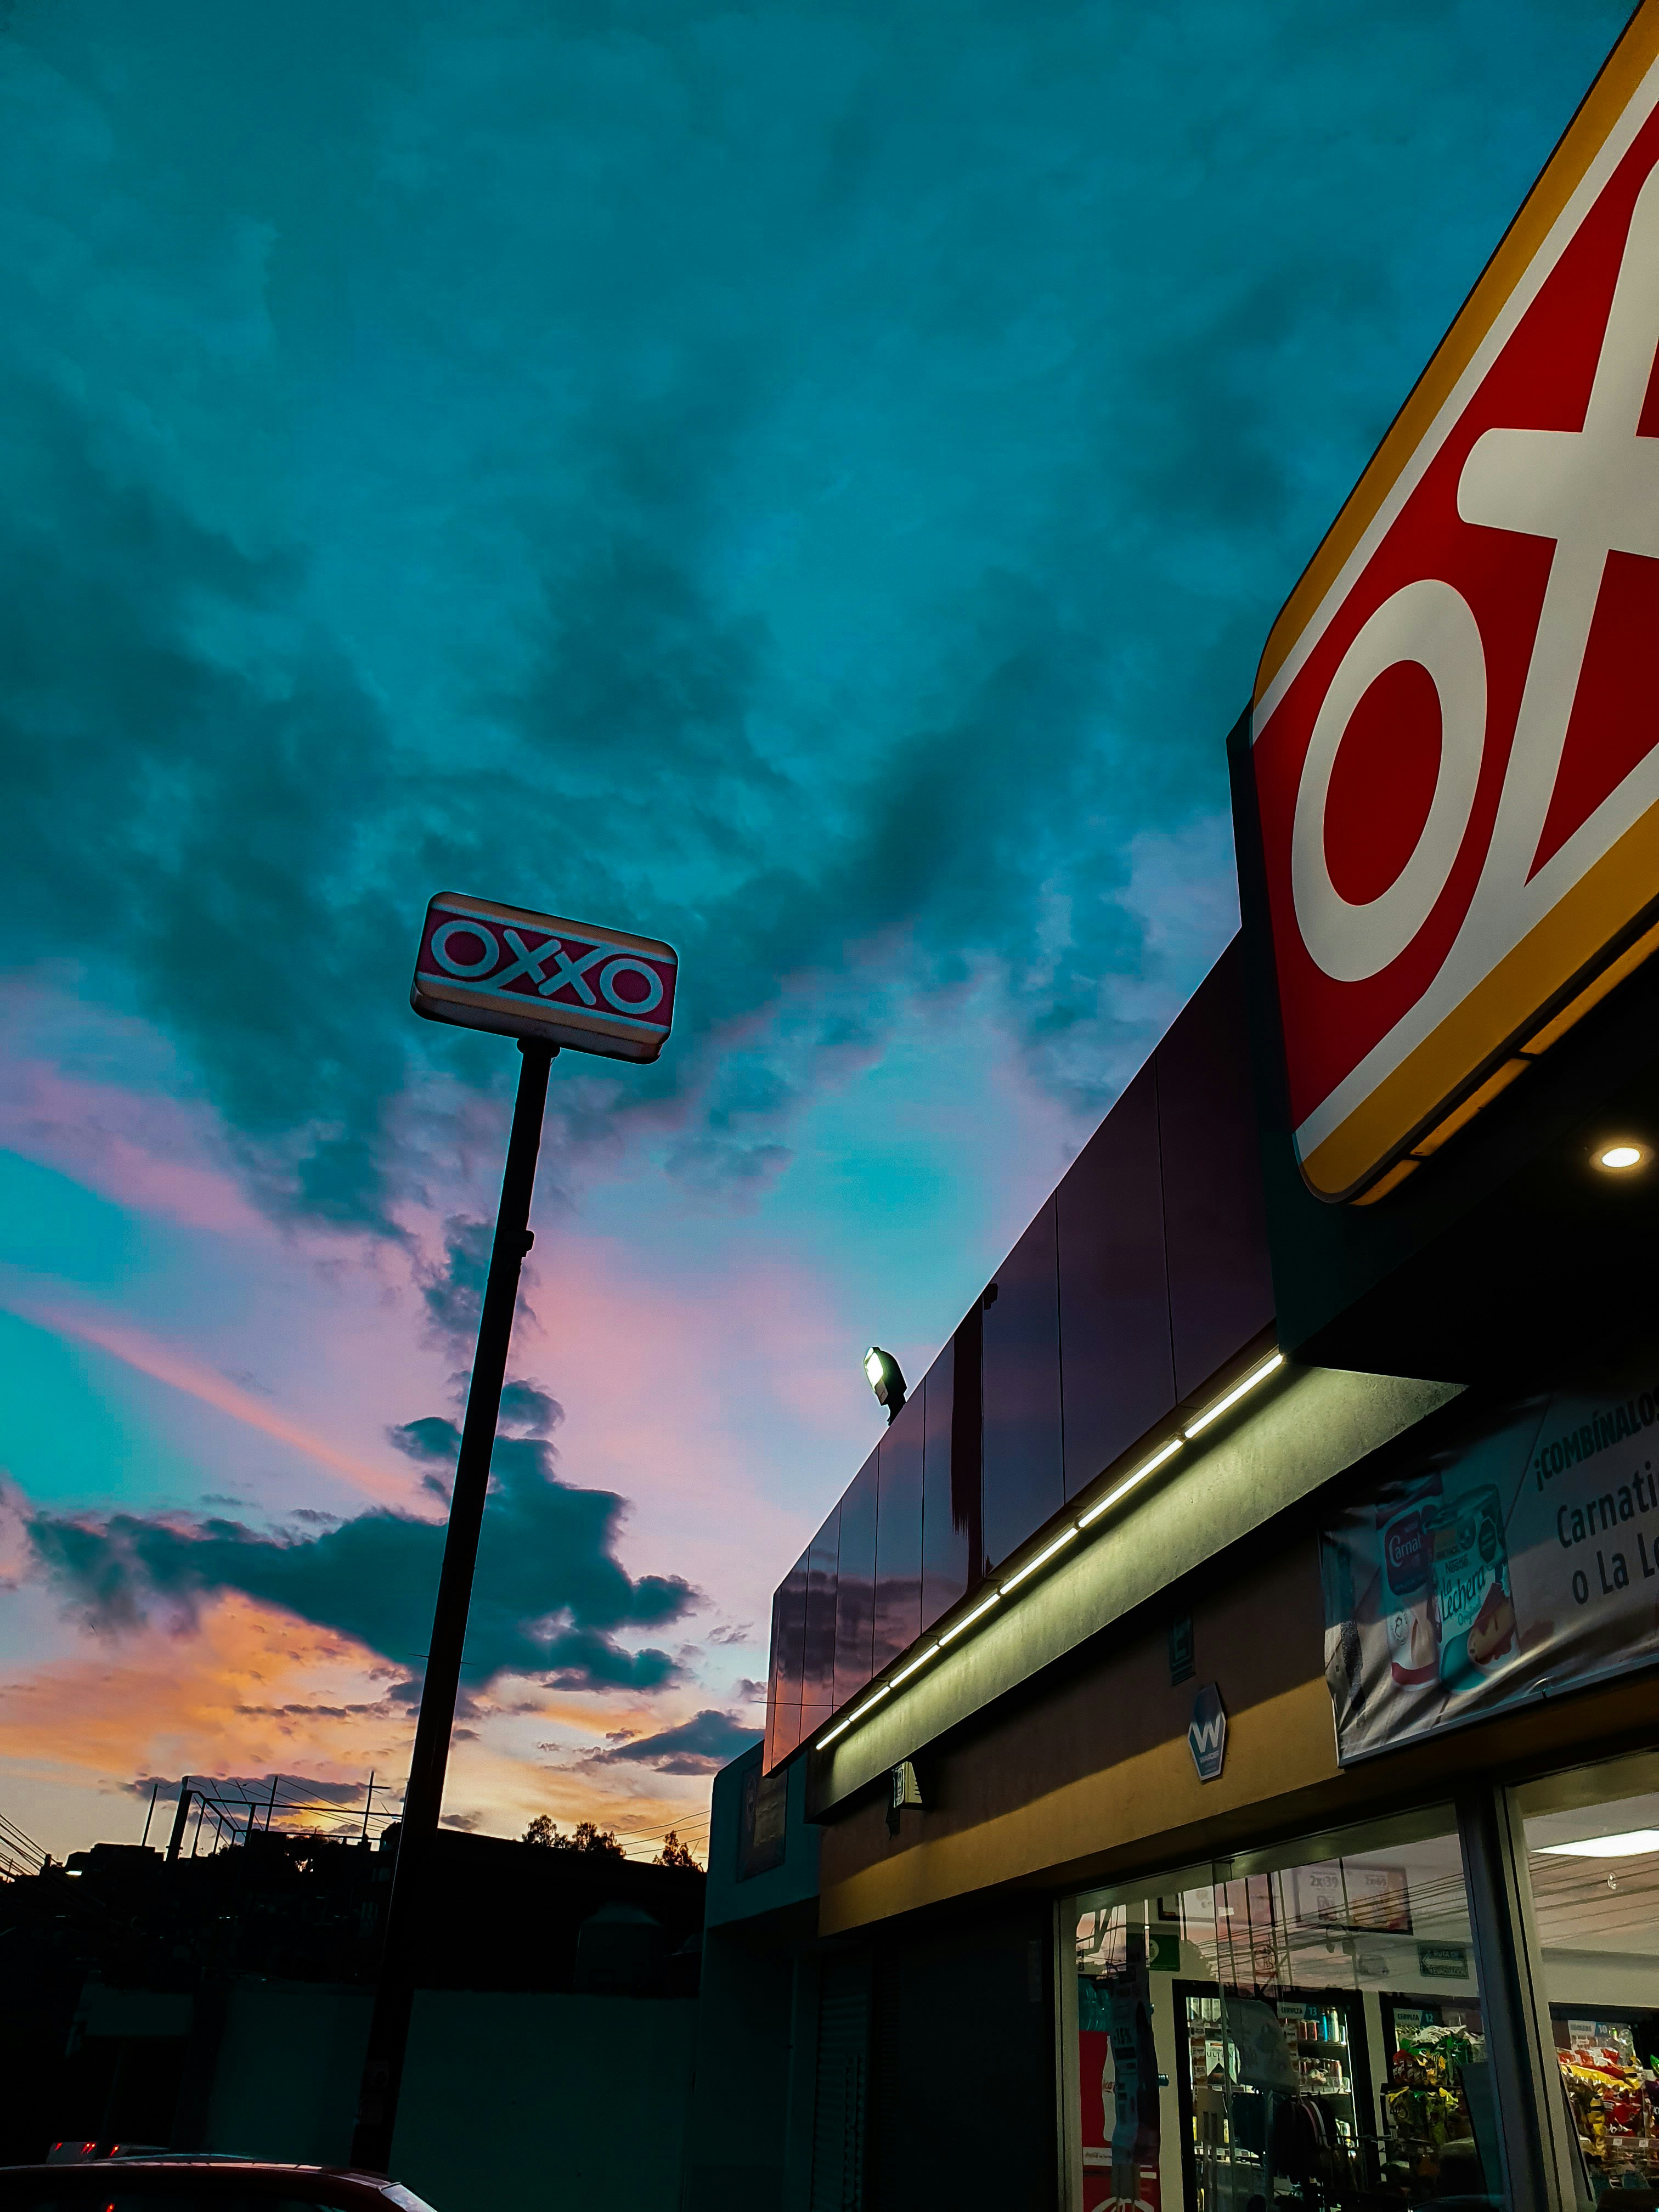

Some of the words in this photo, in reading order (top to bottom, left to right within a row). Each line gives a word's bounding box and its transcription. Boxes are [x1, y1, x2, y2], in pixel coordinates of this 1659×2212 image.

[431, 920, 664, 1014] OXXO
[1557, 1460, 1659, 1549] Carnati
[1440, 1565, 1486, 1622] Lechera
[1572, 1570, 1589, 1605] o
[1596, 1550, 1629, 1595] La
[1309, 2007, 1317, 2017] 13
[1425, 2013, 1434, 2023] 12
[1598, 2024, 1608, 2034] 10
